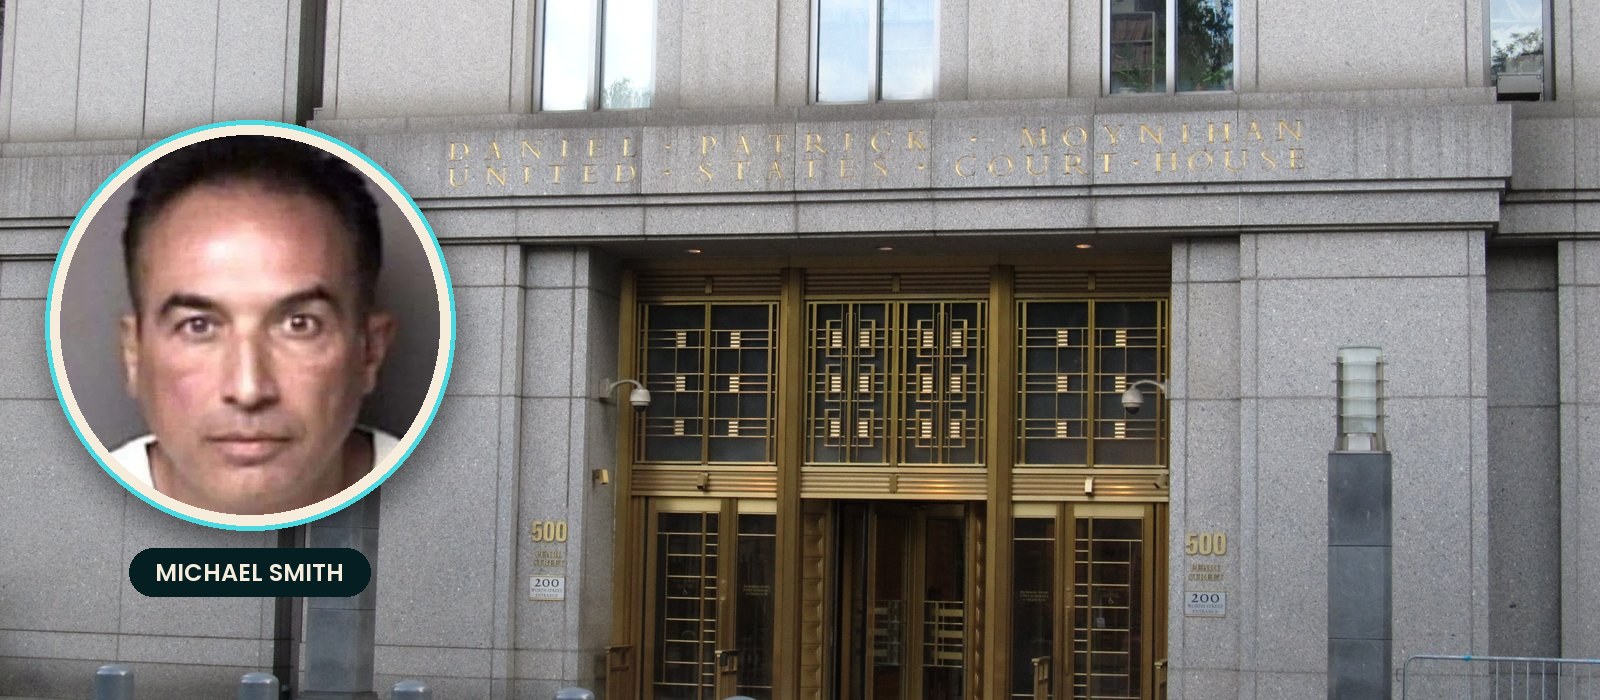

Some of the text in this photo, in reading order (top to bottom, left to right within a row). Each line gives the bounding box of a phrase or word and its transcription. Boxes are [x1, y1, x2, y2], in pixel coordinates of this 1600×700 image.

[449, 119, 1303, 161] DANIEL PATRICK MOYNIHAN
[449, 148, 1306, 187] UNITED STATES COURT HOUSE
[531, 521, 567, 542] 500
[1185, 533, 1227, 556] 500
[535, 578, 560, 588] 200
[1191, 593, 1220, 603] 200
